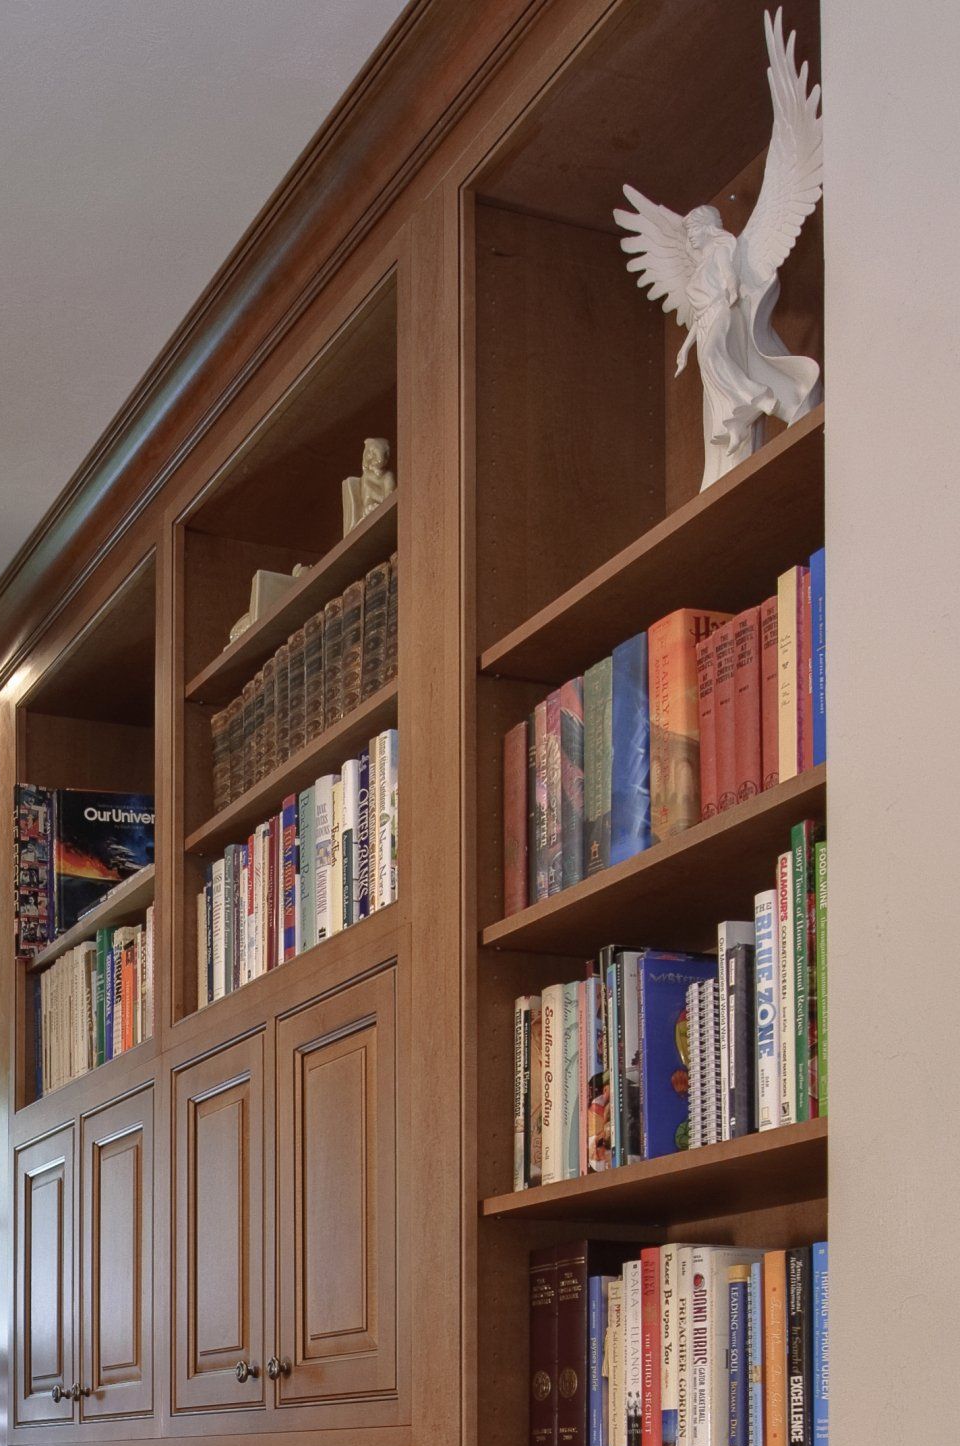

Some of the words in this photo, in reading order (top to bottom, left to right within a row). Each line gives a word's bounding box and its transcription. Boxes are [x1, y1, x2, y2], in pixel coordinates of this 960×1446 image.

[84, 807, 111, 822] Our
[111, 808, 155, 825] Univer
[359, 788, 369, 842] OUTER
[359, 844, 370, 901] BANKS
[819, 847, 827, 876] FOOD
[300, 862, 310, 902] Road
[780, 857, 788, 922] GLAMOUR'S
[796, 874, 804, 904] Taste
[819, 882, 827, 910] WINE
[796, 906, 805, 919] of
[755, 912, 773, 985] BLUE
[796, 919, 805, 951] Home
[796, 954, 805, 992] Annual
[757, 987, 778, 1060] ZONE
[796, 994, 805, 1036] Recipes
[544, 1005, 555, 1068] Southern
[543, 1070, 555, 1127] Cooking
[631, 1269, 640, 1308] SARA
[820, 1270, 829, 1316] TRIPPING
[730, 1286, 739, 1331] LEADING
[663, 1316, 671, 1340] upon
[679, 1298, 687, 1373] PREACHER
[820, 1331, 829, 1361] PROM
[591, 1337, 599, 1365] paynes
[664, 1342, 673, 1366] You
[730, 1348, 739, 1374] SOUL
[591, 1366, 599, 1392] prairie
[698, 1367, 706, 1385] GATOR
[820, 1364, 829, 1400] QUEEN
[679, 1377, 688, 1439] GORDON
[790, 1375, 804, 1443] EXCELLENCE
